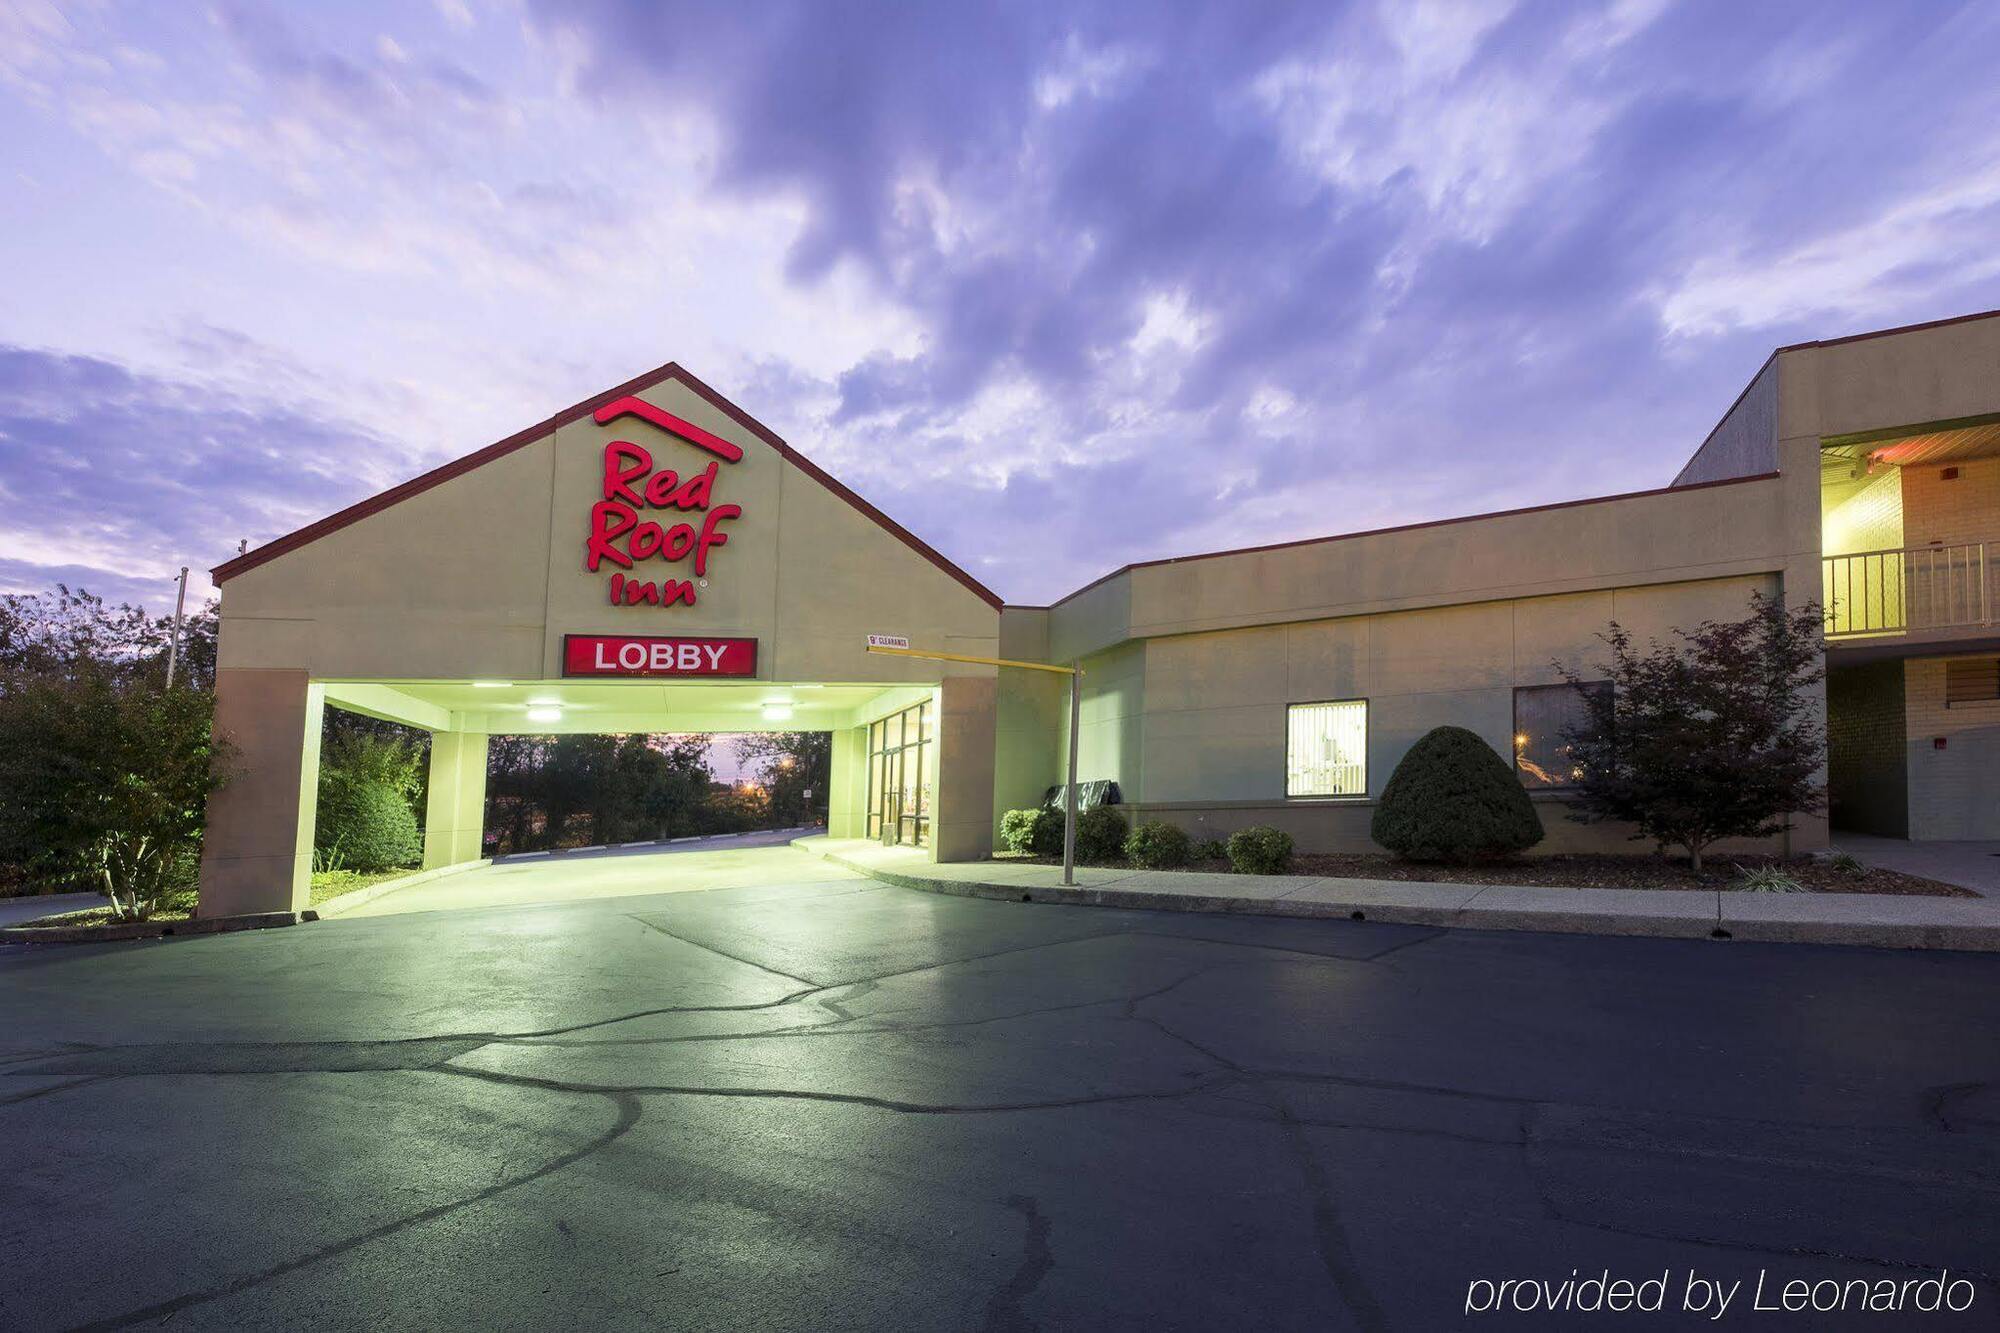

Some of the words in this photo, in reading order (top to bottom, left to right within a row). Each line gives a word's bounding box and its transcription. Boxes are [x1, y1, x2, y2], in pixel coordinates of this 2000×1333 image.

[603, 440, 719, 511] Red
[586, 499, 742, 577] Roof
[610, 573, 697, 606] Inn
[594, 642, 728, 671] LOBBY
[878, 636, 908, 647] CLEARANCE
